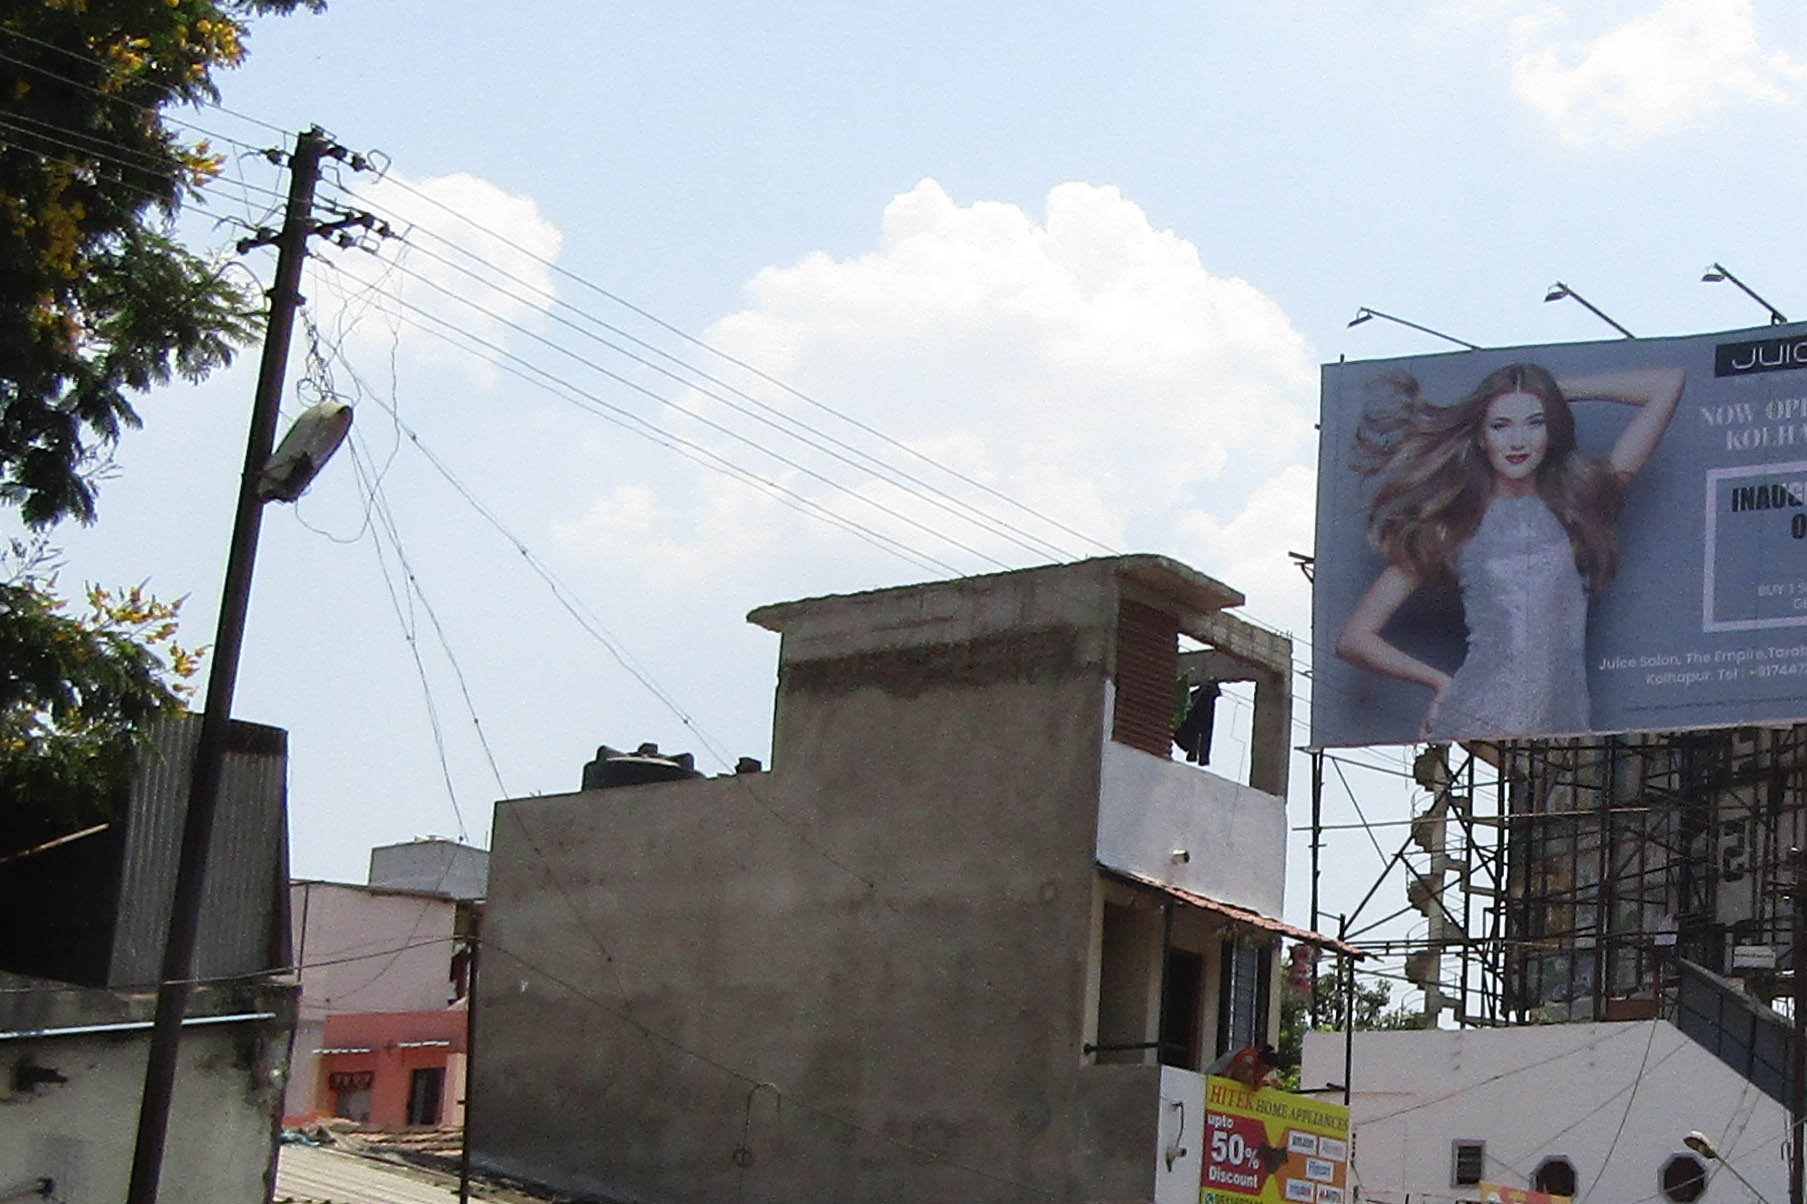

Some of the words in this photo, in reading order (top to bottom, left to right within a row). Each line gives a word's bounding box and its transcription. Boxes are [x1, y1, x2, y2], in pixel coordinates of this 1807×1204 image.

[1699, 402, 1754, 427] NOW
[1686, 652, 1711, 664] The
[1256, 1099, 1289, 1119] HOME
[1207, 1114, 1234, 1129] upto
[1211, 1129, 1260, 1170] 50%
[1208, 1165, 1259, 1190] Discount
